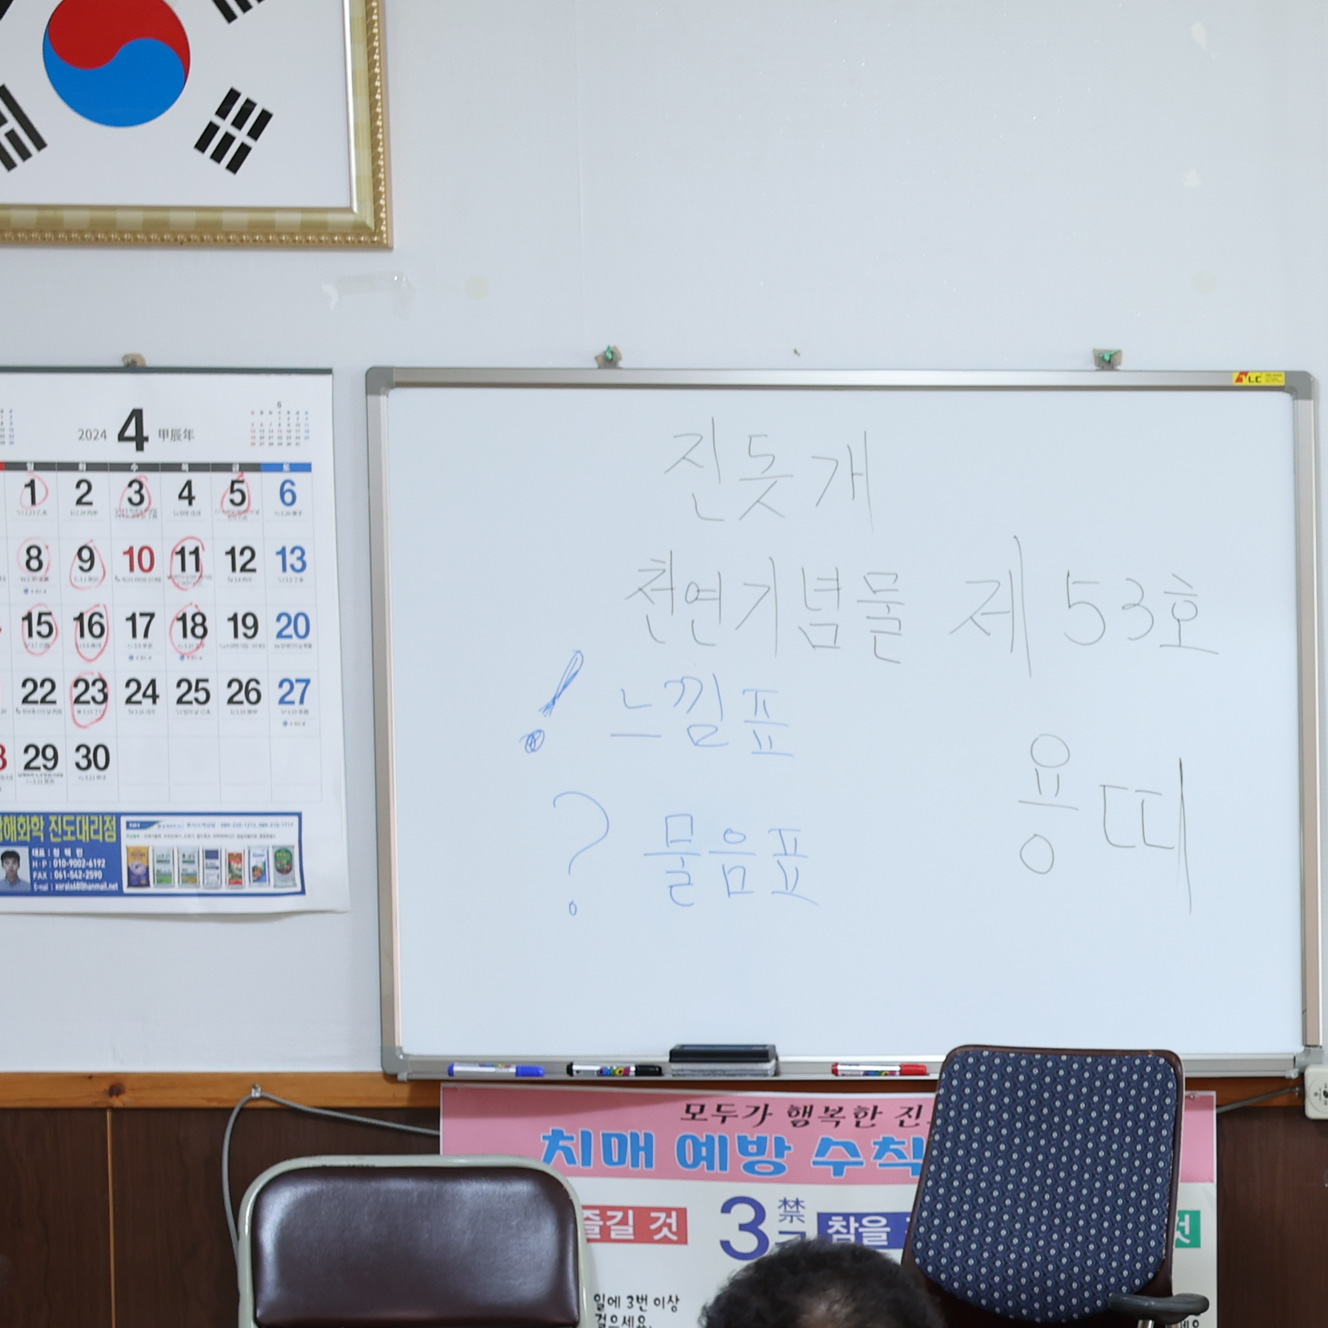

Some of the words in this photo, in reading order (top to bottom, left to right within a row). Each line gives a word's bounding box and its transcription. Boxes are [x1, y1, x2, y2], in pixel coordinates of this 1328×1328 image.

[78, 428, 108, 441] 2024
[117, 408, 149, 452] 4
[158, 428, 195, 442] 甲辰年
[24, 478, 37, 506] 1
[75, 478, 93, 506] 2
[127, 478, 146, 506] 3
[178, 478, 196, 506] 4
[229, 478, 247, 506] 5
[279, 478, 297, 506] 6
[25, 545, 44, 573] 8
[77, 545, 96, 573] 9
[123, 545, 155, 573] 10
[175, 545, 201, 573] 11
[225, 545, 257, 573] 12
[275, 545, 307, 573] 13
[625, 550, 906, 665] 천연기념물
[21, 612, 54, 640] 15
[73, 612, 106, 640] 16
[125, 612, 156, 640] 17
[176, 612, 208, 640] 18
[227, 612, 259, 640] 19
[275, 612, 311, 640] 20
[21, 678, 57, 706] 22
[73, 678, 109, 706] 23
[124, 678, 160, 706] 24
[175, 678, 211, 706] 25
[226, 678, 262, 706] 26
[278, 678, 311, 706] 27
[610, 673, 794, 757] 느낌표
[23, 744, 59, 772] 29
[74, 744, 111, 772] 30
[0, 815, 45, 843] 해화학
[49, 815, 118, 843] 진도대리점
[1018, 733, 1192, 916] 용띠
[643, 812, 820, 907] 물음표
[33, 871, 48, 881] FAX
[680, 1102, 773, 1127] 모두가
[786, 1104, 883, 1129] 행복한
[893, 1104, 932, 1130] 진
[542, 1127, 655, 1170] 치매
[675, 1132, 793, 1178] 예방
[649, 1210, 679, 1242] 것
[827, 1214, 892, 1248] 참을
[626, 1293, 649, 1313] 3번
[653, 1293, 681, 1314] 이상
